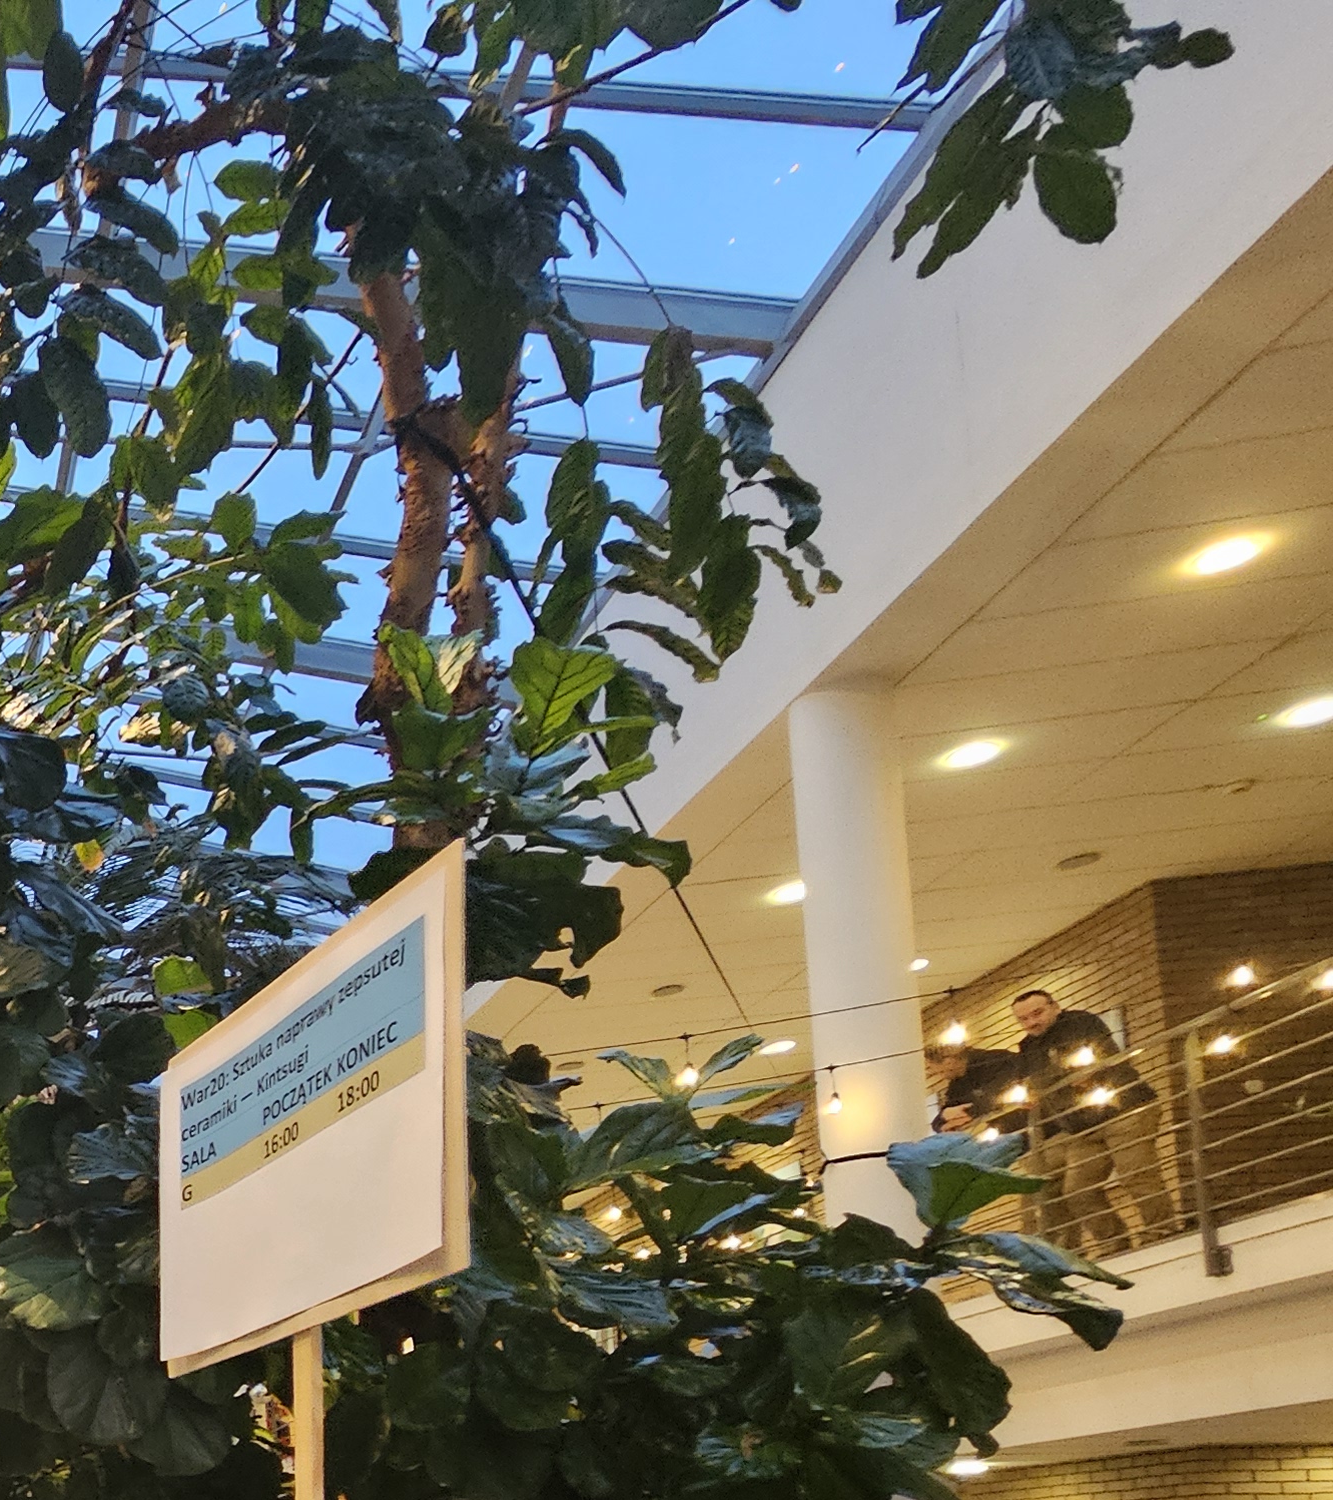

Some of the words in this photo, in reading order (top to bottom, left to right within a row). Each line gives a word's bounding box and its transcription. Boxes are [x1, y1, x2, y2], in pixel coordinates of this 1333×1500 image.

[180, 1073, 230, 1111] War20:
[233, 1042, 273, 1081] Sztuka
[276, 995, 334, 1050] naprawy
[337, 938, 406, 1003] zepsutej
[181, 1094, 238, 1142] ceramiki
[257, 1044, 309, 1097] Kintsugi
[181, 1141, 218, 1173] SALA
[262, 1063, 333, 1126] POCZĄTEK
[337, 1020, 399, 1077] KONIEC
[181, 1183, 193, 1202] G
[263, 1121, 300, 1160] 16:00
[337, 1070, 380, 1113] 18:00
